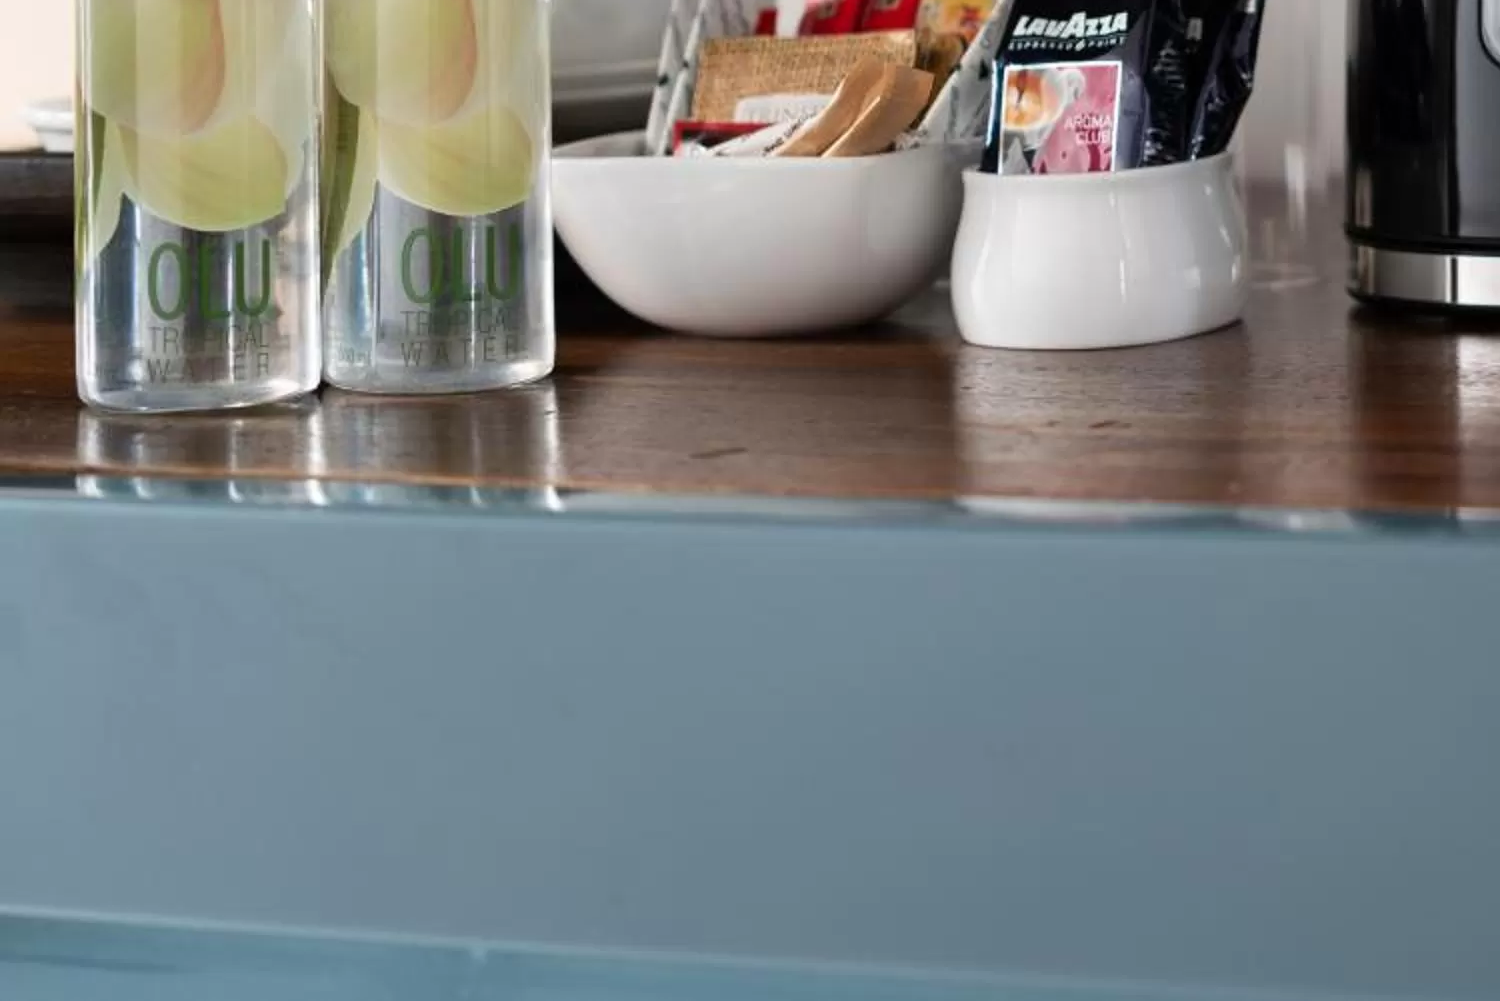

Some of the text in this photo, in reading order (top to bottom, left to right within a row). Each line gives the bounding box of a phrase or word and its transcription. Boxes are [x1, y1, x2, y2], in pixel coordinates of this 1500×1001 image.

[1012, 11, 1128, 39] LAVAZZA
[1064, 114, 1112, 129] AROMA
[1076, 130, 1111, 145] CLUB
[401, 224, 521, 304] OLU
[147, 239, 272, 320] OLU
